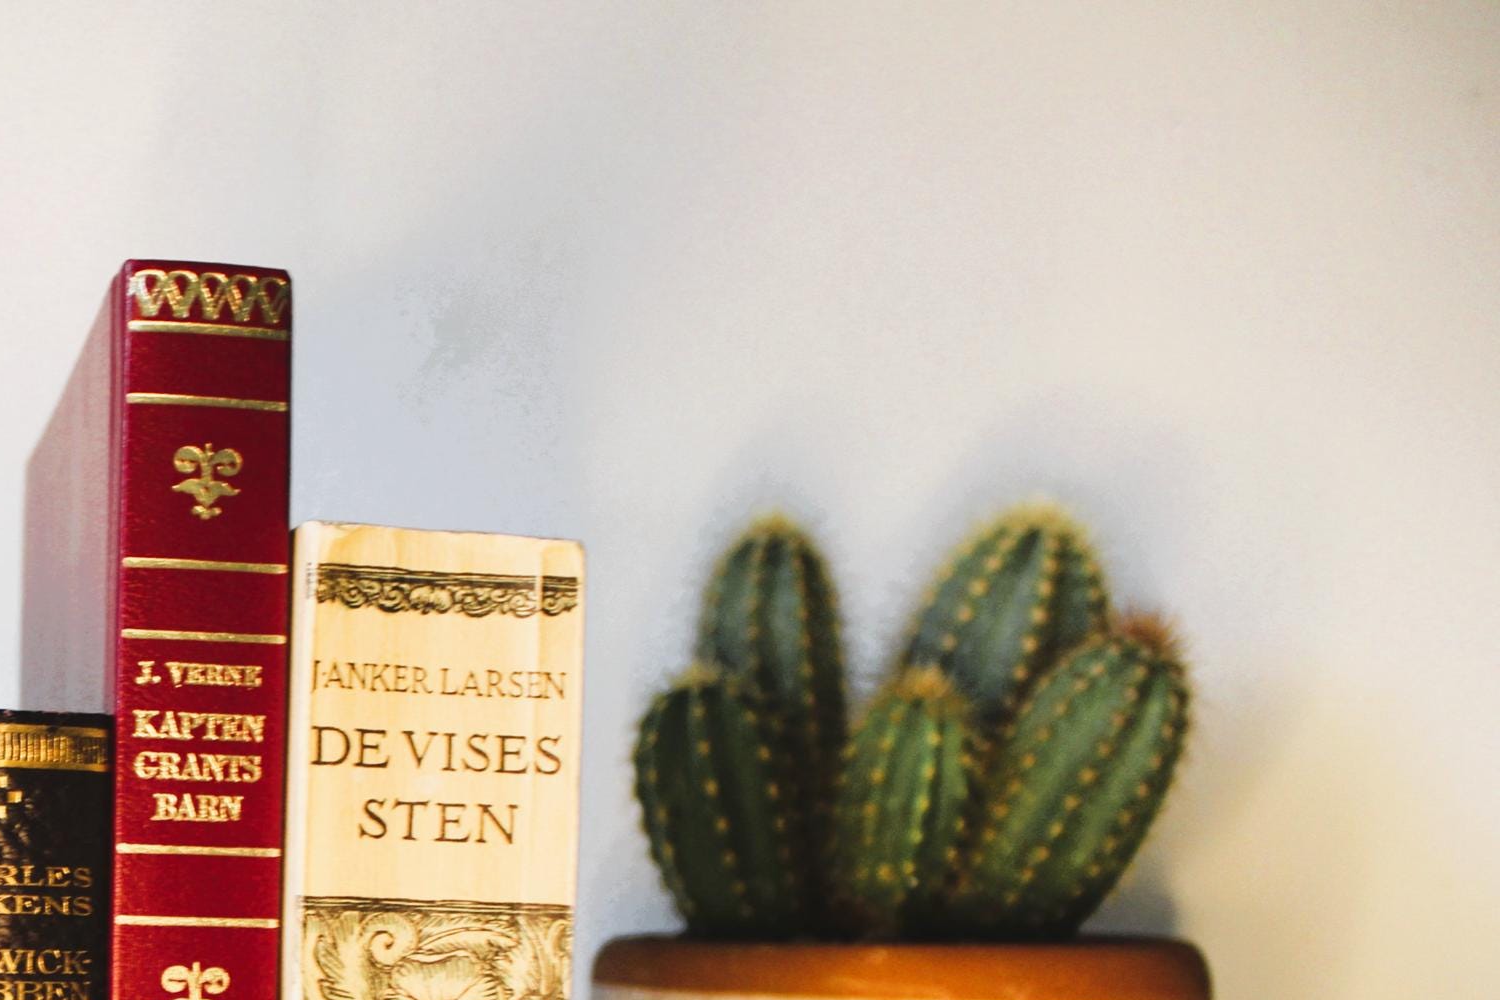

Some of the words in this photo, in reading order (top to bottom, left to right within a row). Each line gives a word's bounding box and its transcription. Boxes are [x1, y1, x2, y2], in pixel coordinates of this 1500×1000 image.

[165, 661, 263, 688] VERNE
[439, 667, 567, 699] LARSEN
[131, 709, 267, 742] KAPTEN
[311, 725, 390, 768] DE
[401, 730, 563, 775] VISES
[133, 751, 263, 783] GRANTS
[150, 793, 245, 822] BARN
[358, 798, 519, 844] STEN
